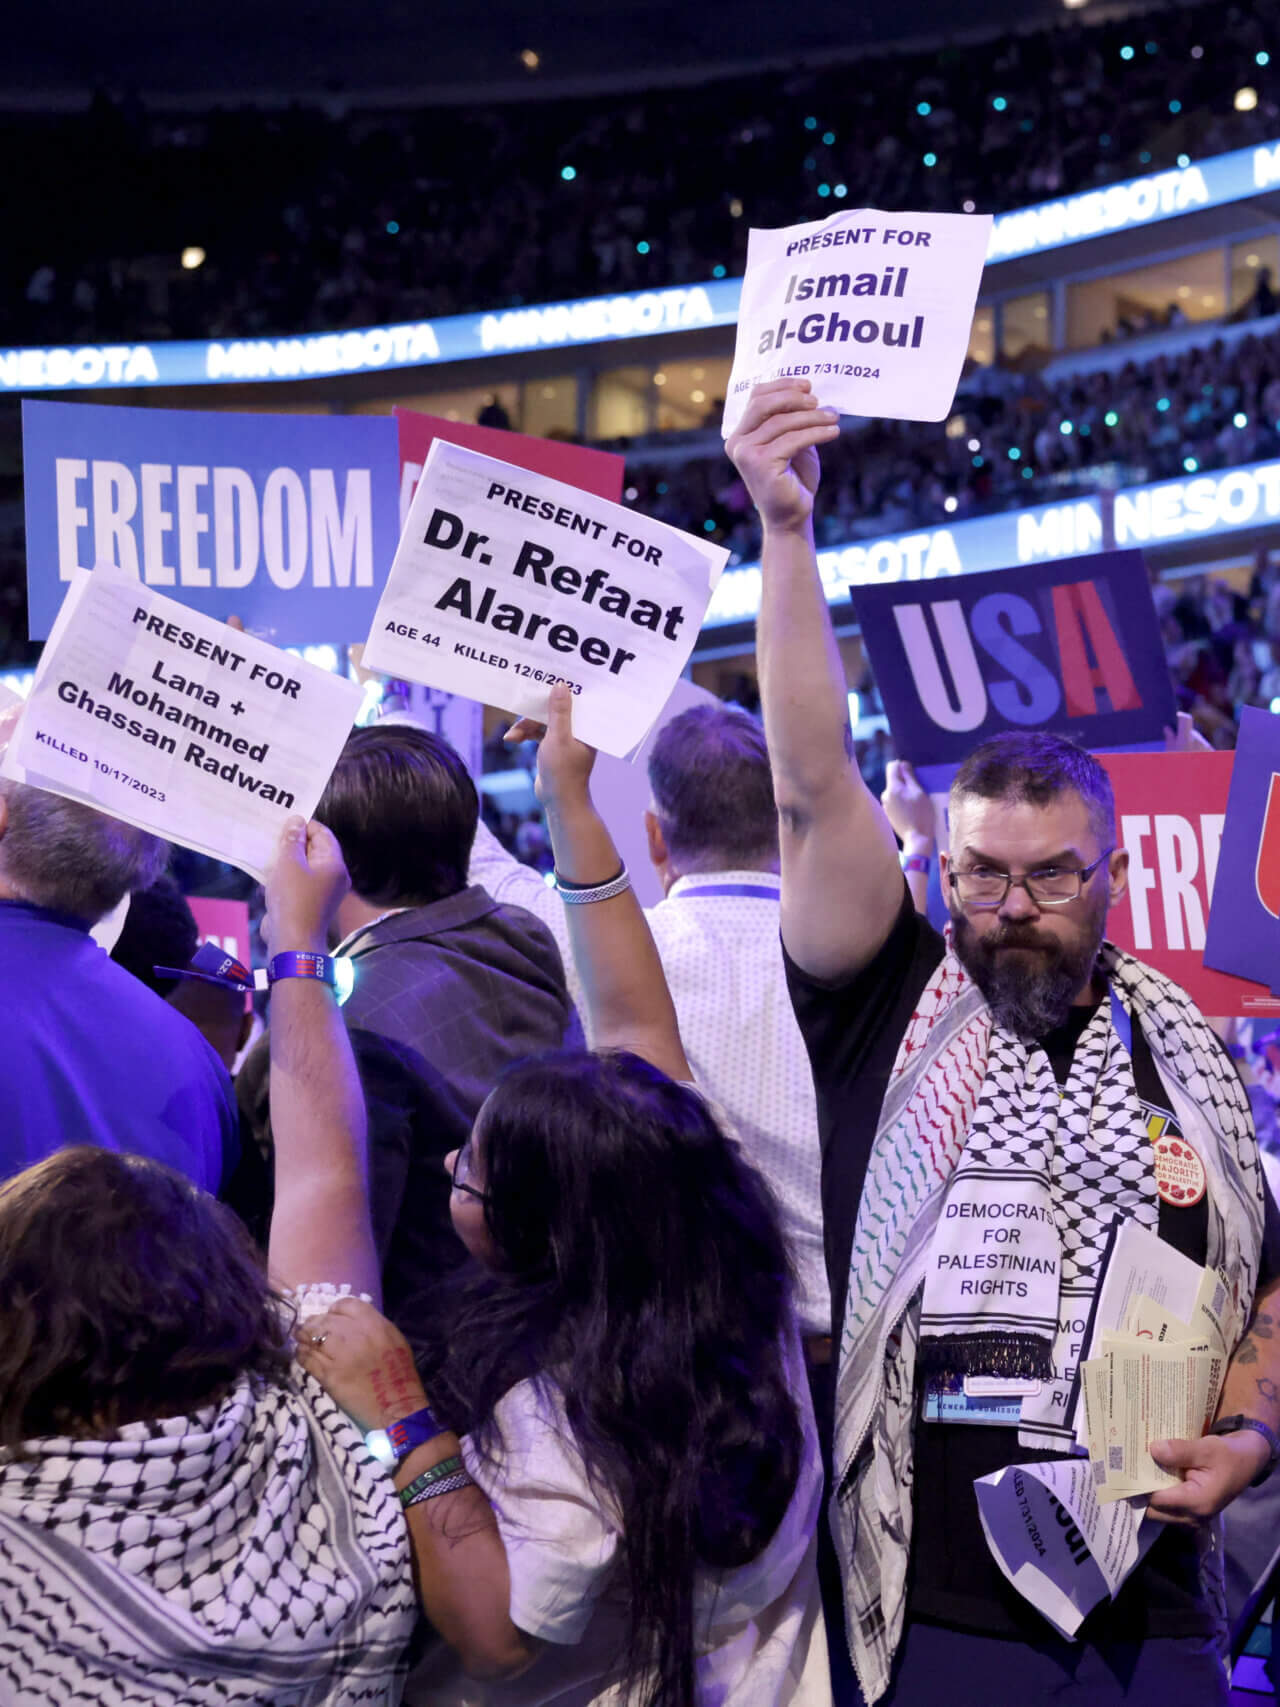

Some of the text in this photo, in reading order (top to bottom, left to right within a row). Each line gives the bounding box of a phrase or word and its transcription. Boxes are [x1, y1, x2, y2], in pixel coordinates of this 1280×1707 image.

[786, 228, 931, 257] PRESENT FOR
[784, 266, 909, 305] Ismail
[480, 287, 714, 351] MINNESOTA
[757, 312, 924, 355] al-Ghoul
[207, 323, 440, 379] MINNESOTA
[771, 364, 810, 380] ILLED
[814, 363, 880, 379] 7/31/2024
[56, 458, 374, 590] FREEDOM
[486, 482, 664, 567] PRESENT FOR
[423, 508, 684, 641] Dr. Refaat
[132, 606, 246, 672] PRESENT
[249, 663, 302, 700] FOR
[385, 620, 418, 640] AGE
[421, 632, 441, 648] 44
[453, 642, 509, 671] KILLED
[434, 577, 636, 676] Alareer
[892, 580, 1143, 733] USA
[151, 660, 246, 717] Lana +
[57, 681, 296, 809] Ghassan Radwan
[106, 672, 270, 764] Mohammed
[35, 730, 167, 803] KILLED 10/17/2023
[946, 1202, 1054, 1226] DEMOCRATS
[983, 1228, 1021, 1244] FOR
[937, 1253, 1056, 1275] PALESTINIAN
[960, 1279, 1028, 1298] RIGHTS
